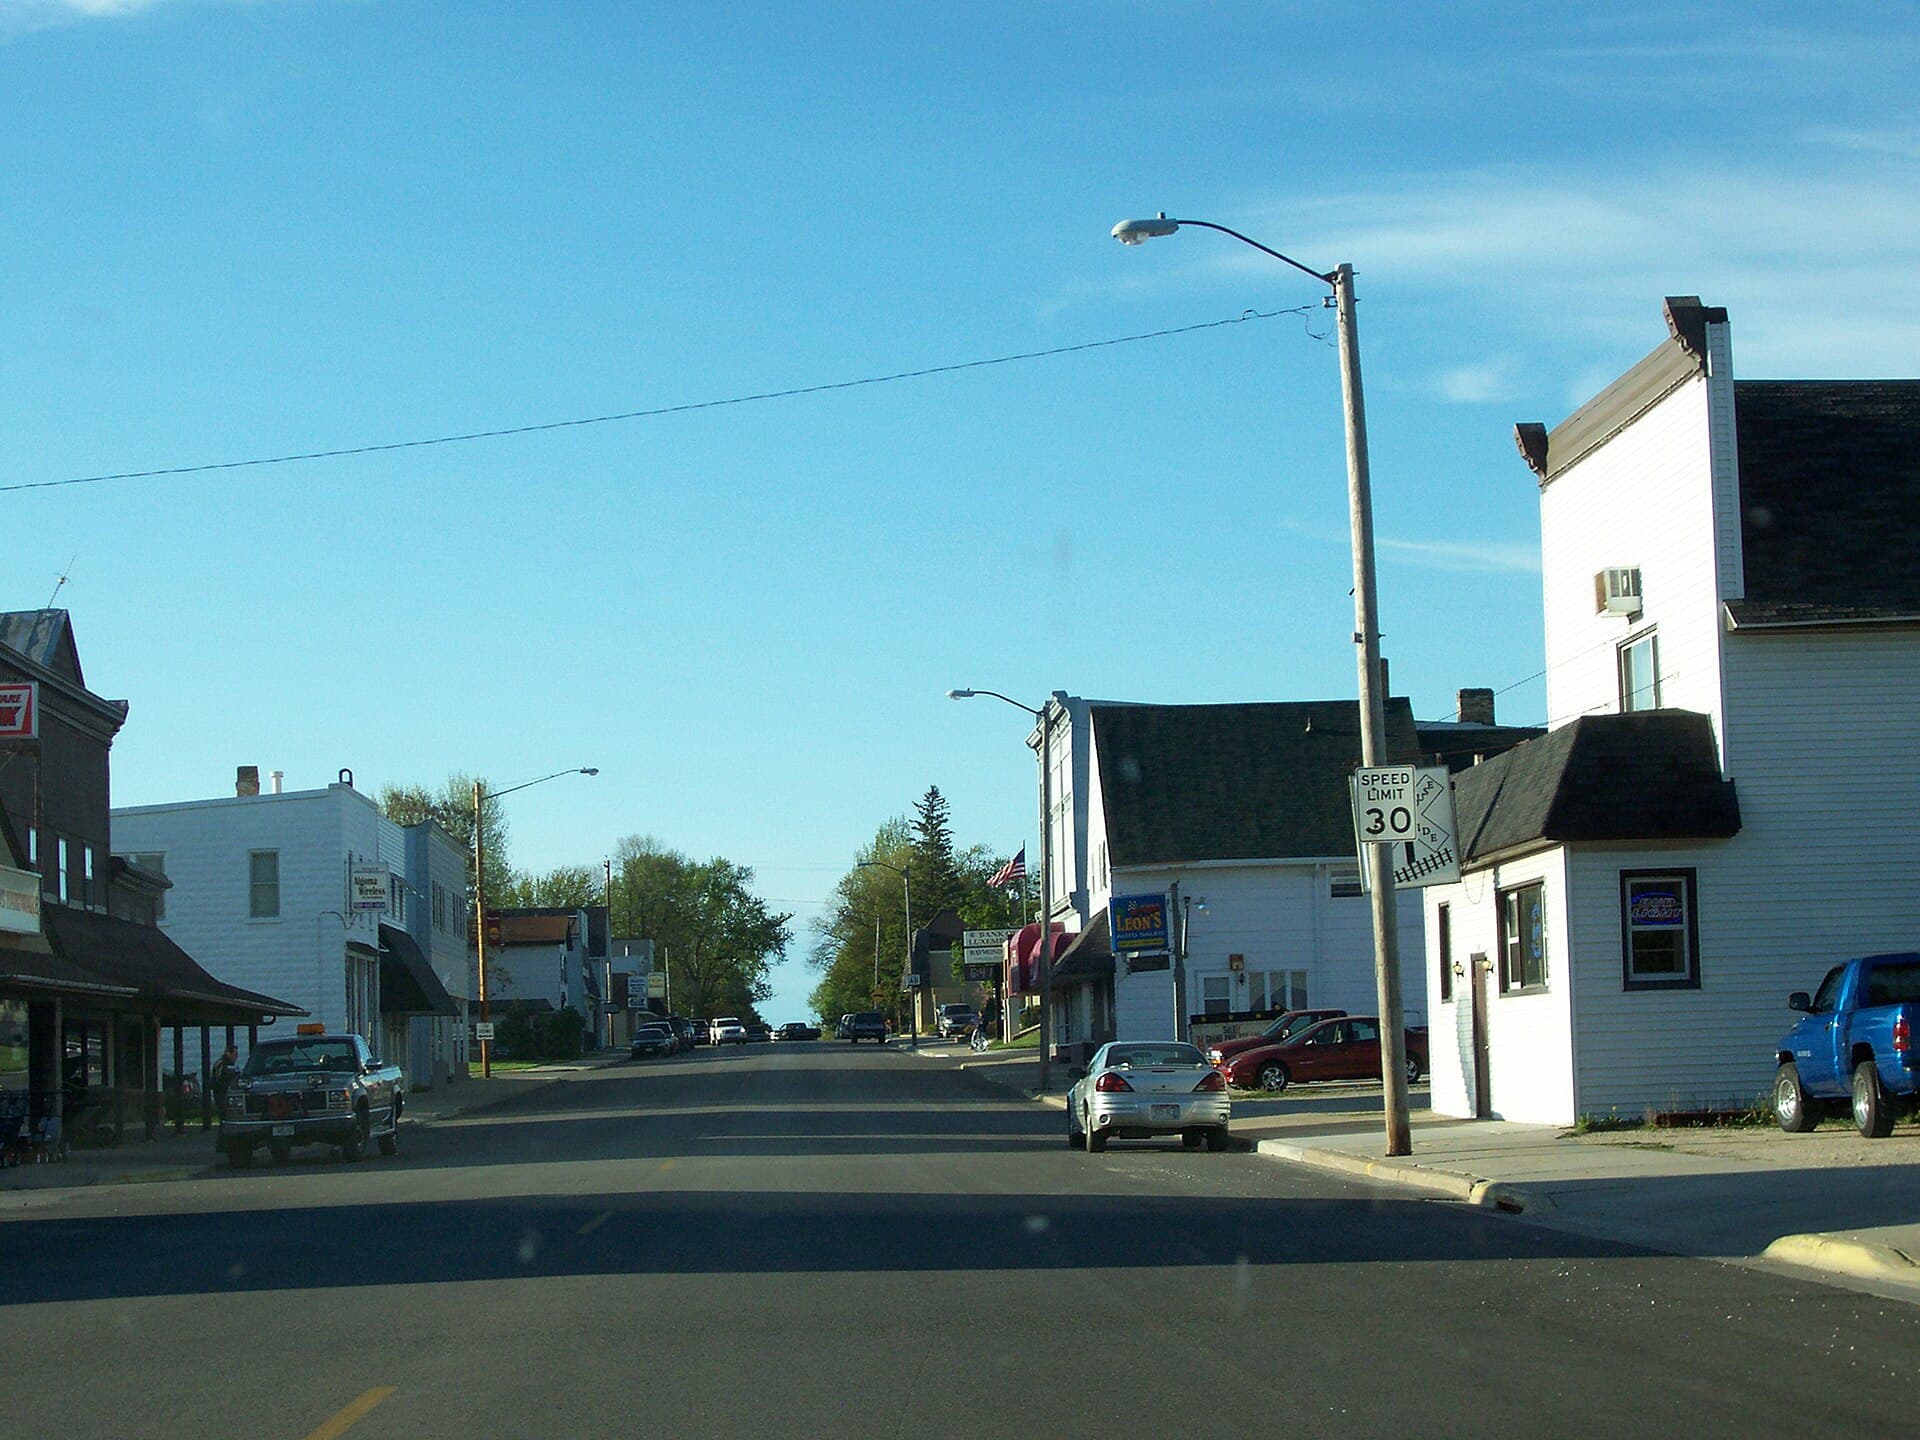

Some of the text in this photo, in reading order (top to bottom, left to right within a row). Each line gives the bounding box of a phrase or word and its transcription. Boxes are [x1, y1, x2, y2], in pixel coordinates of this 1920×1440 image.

[1361, 773, 1410, 786] SPEED
[1367, 788, 1405, 801] LIMIT
[1365, 806, 1412, 835] 30
[1116, 911, 1162, 931] LEON'S
